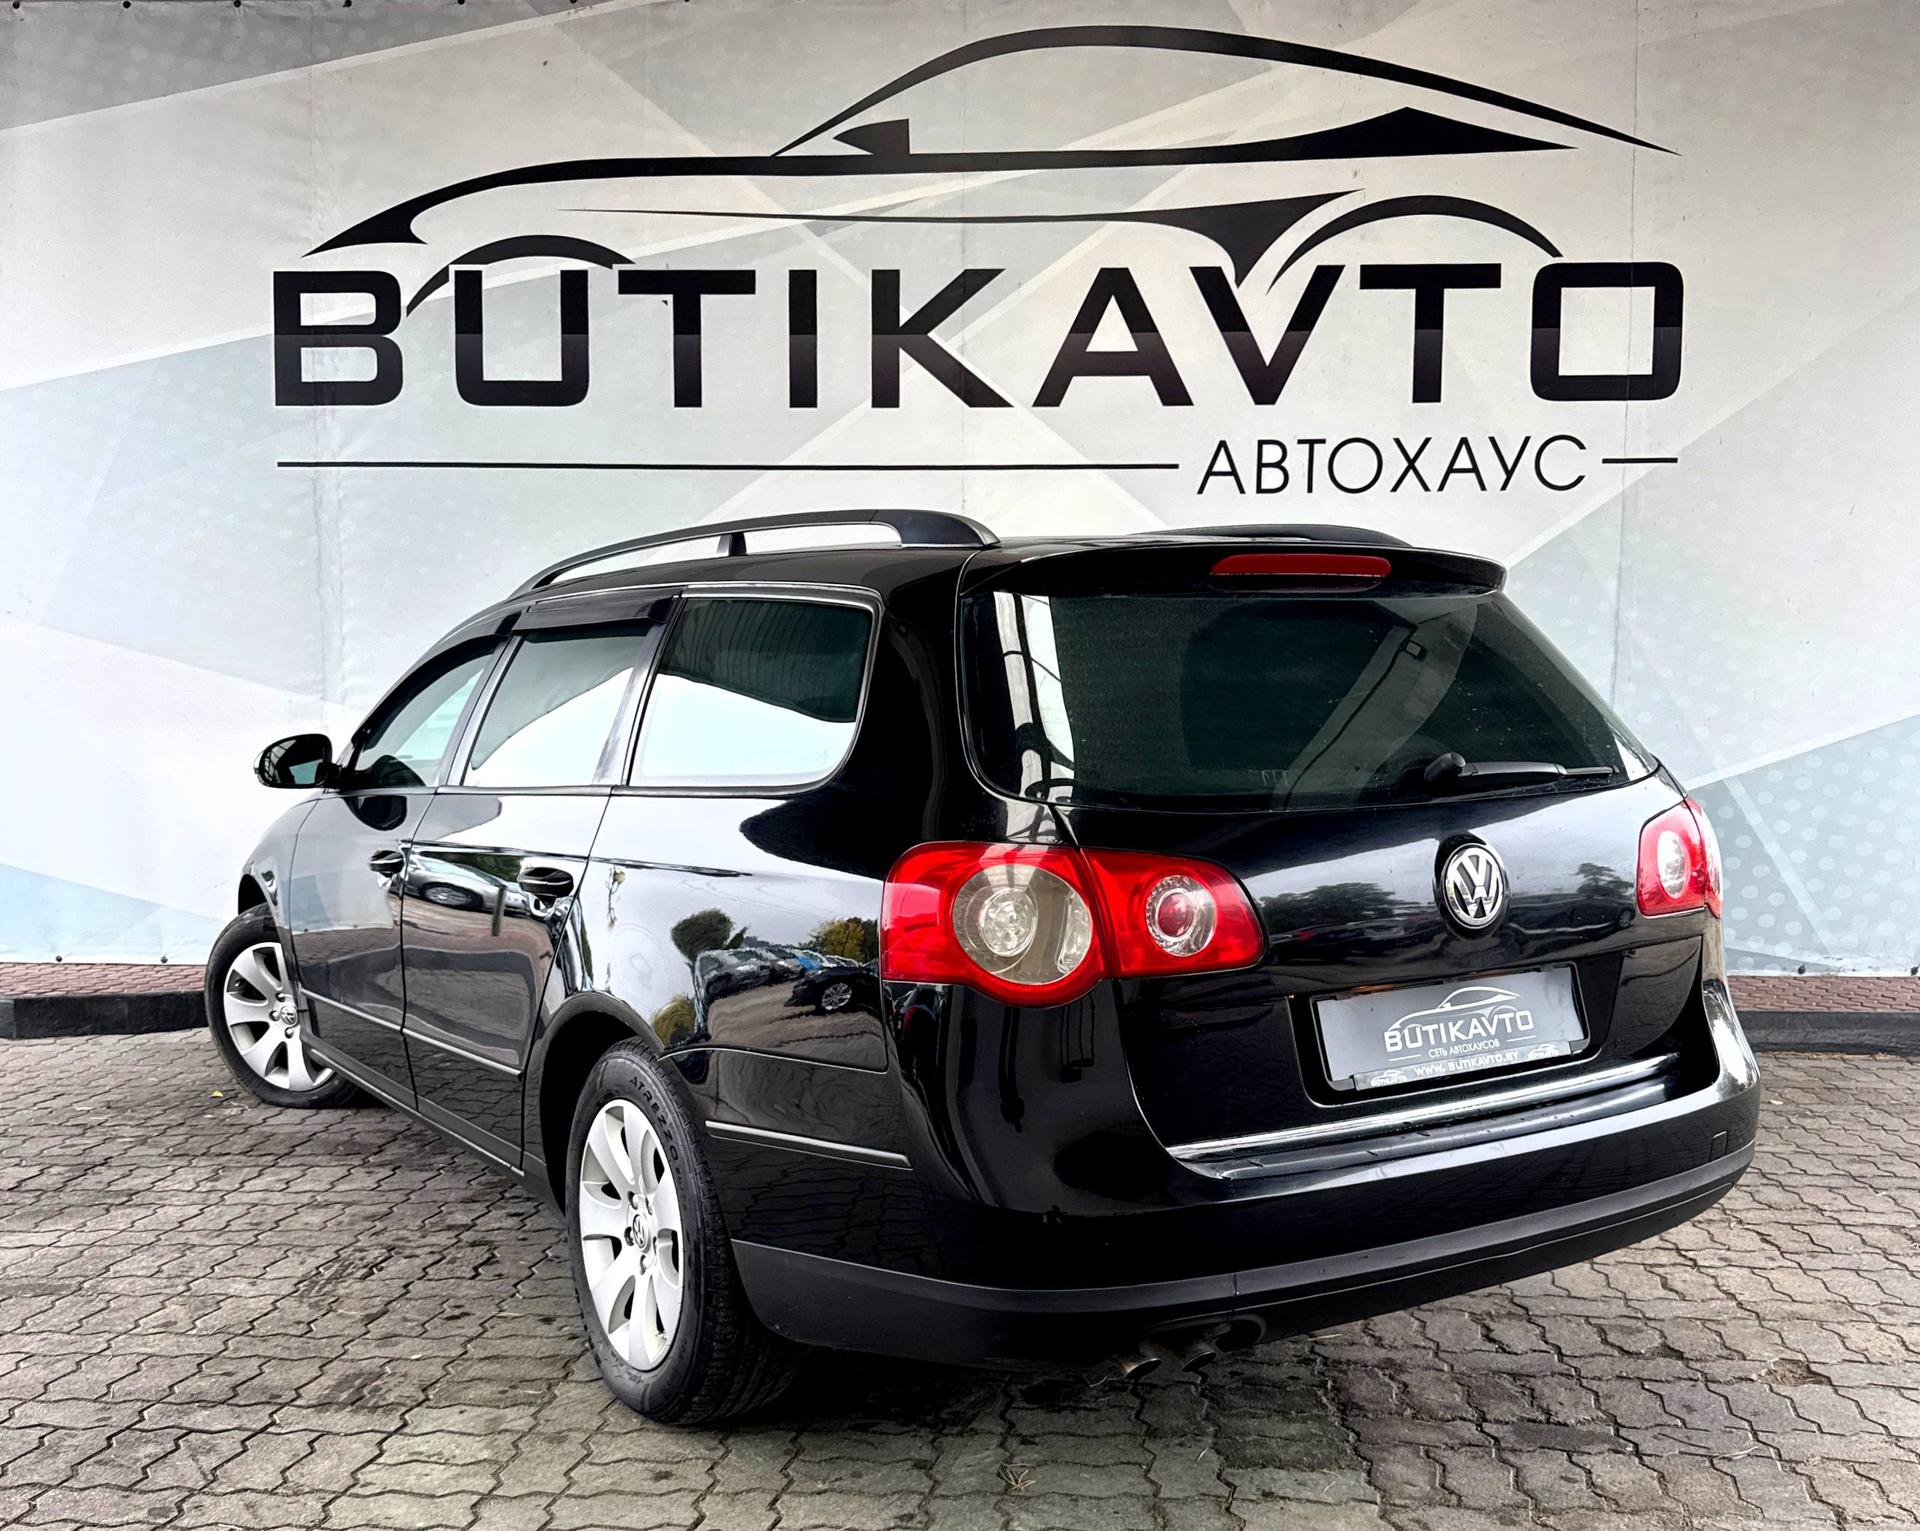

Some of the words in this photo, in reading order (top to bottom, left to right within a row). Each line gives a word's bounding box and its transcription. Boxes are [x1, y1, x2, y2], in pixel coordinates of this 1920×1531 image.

[274, 262, 1684, 409] BUTIKAVTO
[1197, 434, 1587, 495] АВТОХАУС
[1383, 1009, 1534, 1053] BUTIKAVTO
[1428, 1047, 1448, 1058] СЕТЬ
[1449, 1039, 1501, 1055] АВТОХАУСОВ
[629, 1075, 679, 1162] ATREZZO
